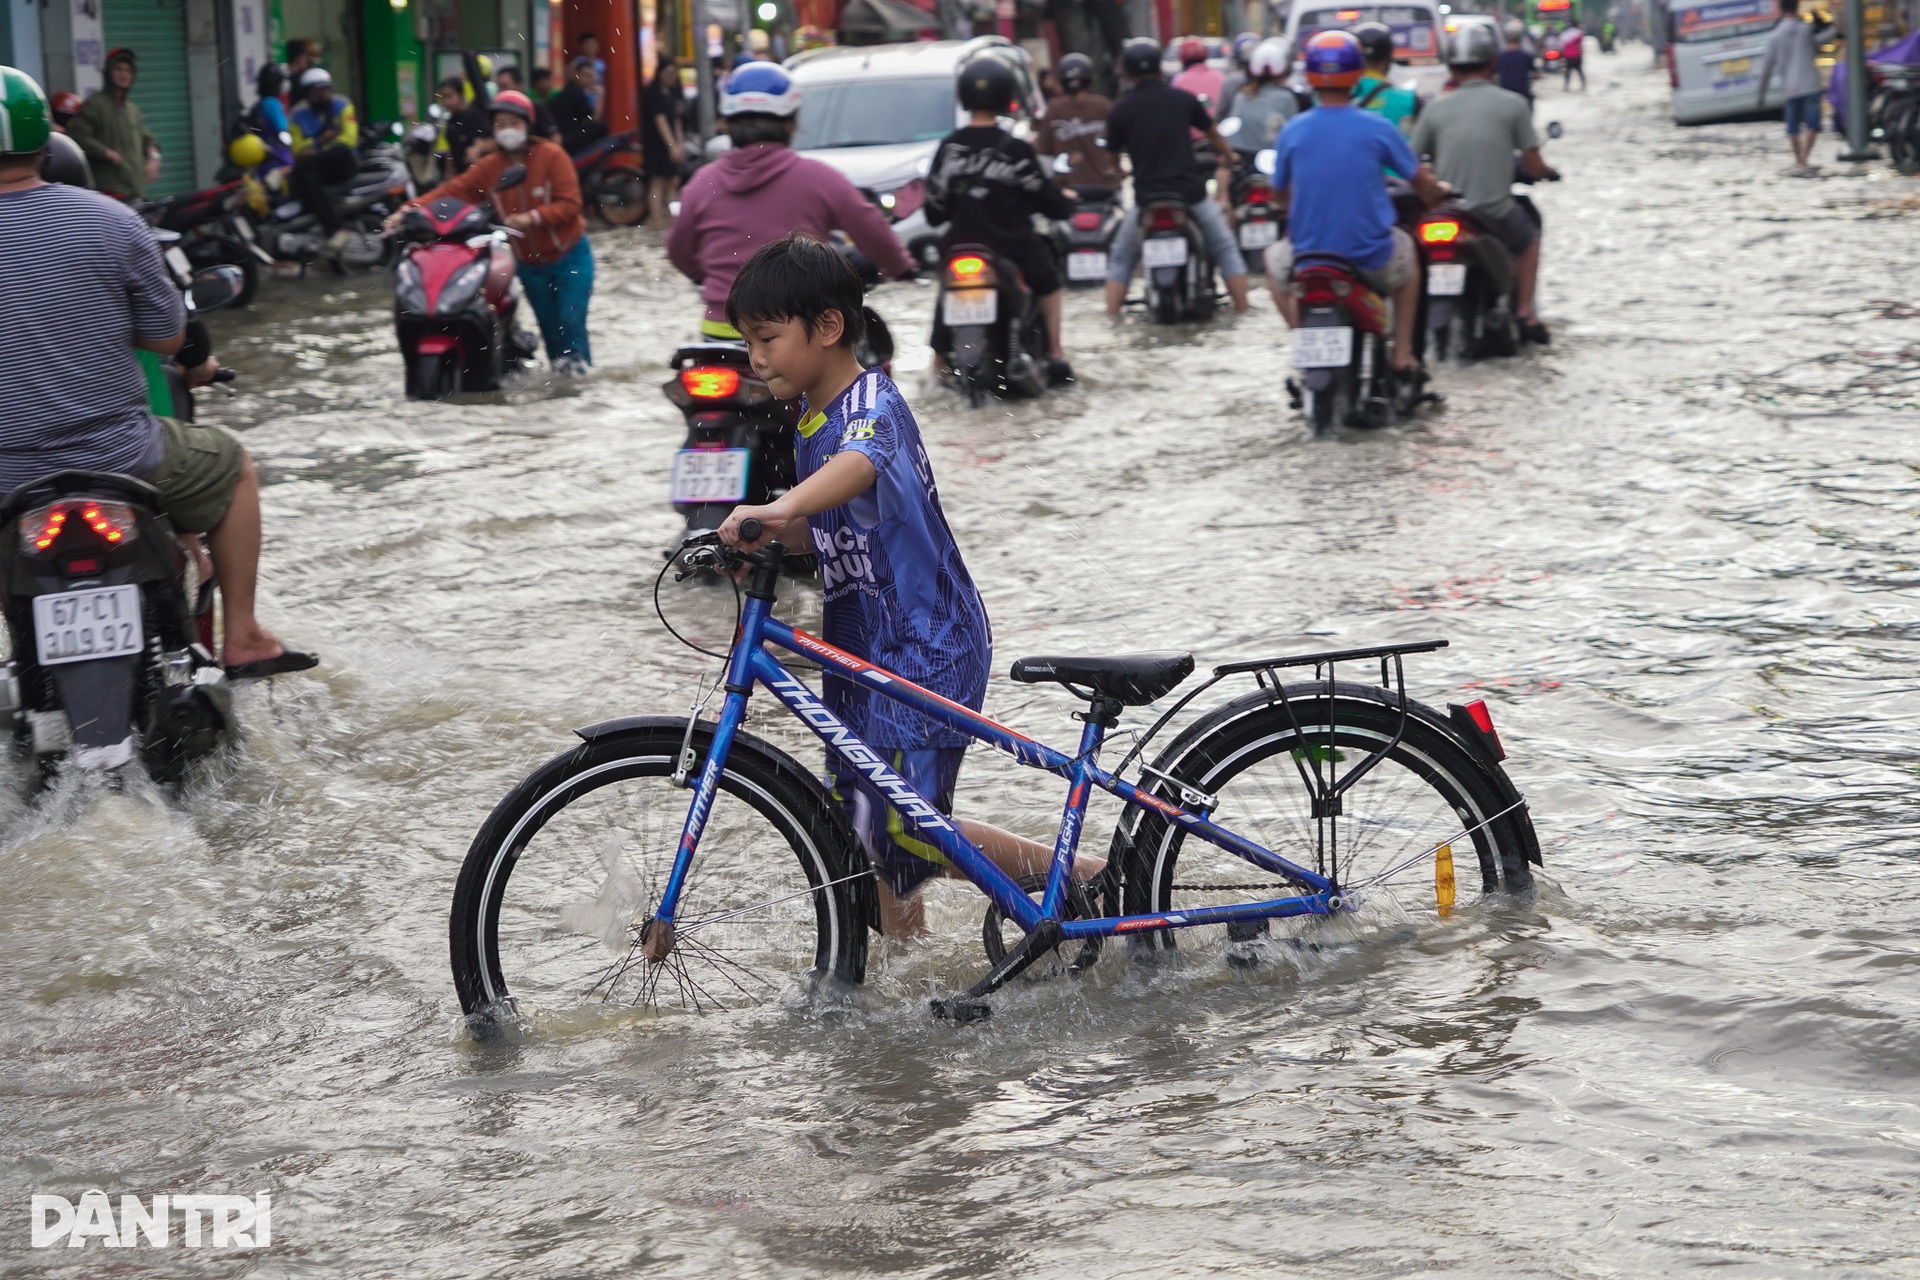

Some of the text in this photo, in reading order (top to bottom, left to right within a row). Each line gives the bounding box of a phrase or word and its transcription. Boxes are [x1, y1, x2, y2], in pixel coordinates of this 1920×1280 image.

[51, 592, 120, 626] 67-C1
[44, 622, 136, 660] 309.92
[798, 635, 861, 669] PANTHER
[772, 667, 955, 832] THONGNHAT
[682, 758, 720, 853] PANTHER
[1057, 810, 1077, 864] FLIGHT
[1121, 919, 1162, 929] PANTHER
